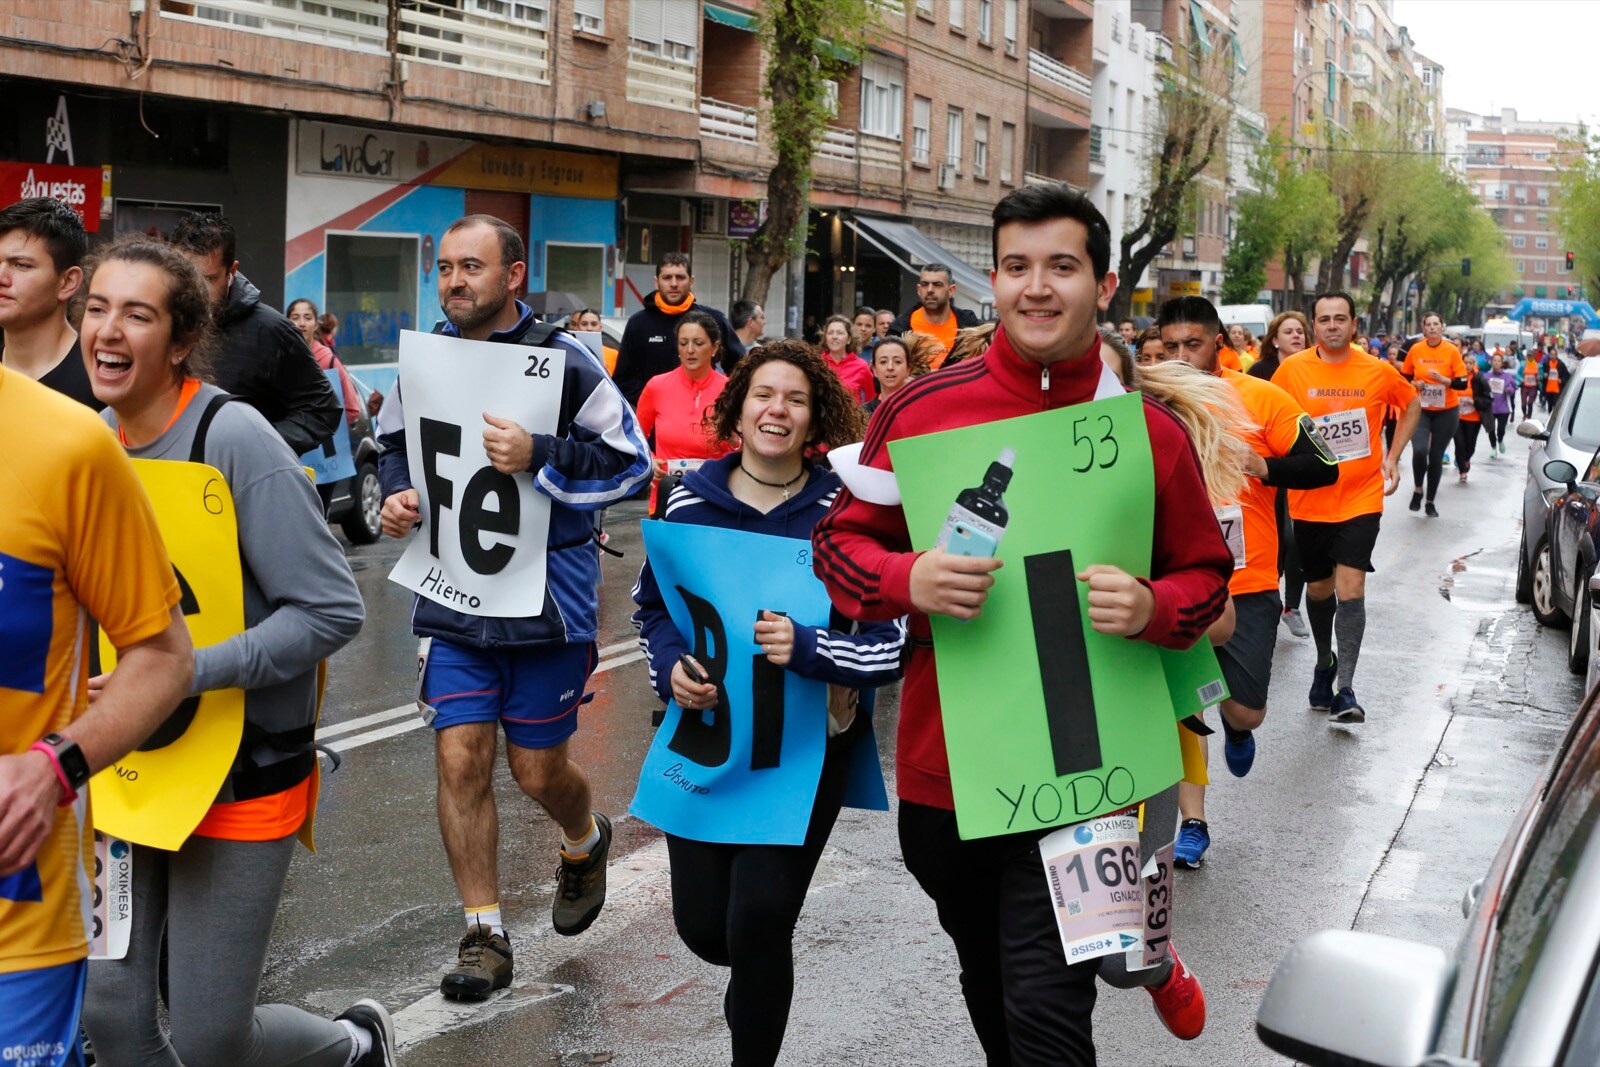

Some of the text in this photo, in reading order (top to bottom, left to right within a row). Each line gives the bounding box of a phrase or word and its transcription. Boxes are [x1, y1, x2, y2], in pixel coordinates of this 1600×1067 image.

[320, 128, 395, 176] LavaCar
[524, 355, 550, 379] 26
[1317, 388, 1366, 397] MARCELINO
[1422, 388, 1442, 398] 2264
[1072, 415, 1119, 474] 53
[1319, 419, 1363, 442] 2255
[203, 478, 223, 514] 6
[420, 417, 520, 576] Fe
[796, 549, 813, 567] 8
[420, 567, 481, 609] Hierro
[996, 766, 1135, 830] YODO
[1094, 819, 1135, 832] OXIMESA
[1049, 865, 1065, 908] MARCELINO
[1065, 845, 1140, 894] 166
[118, 861, 129, 921] OXIMESA
[1146, 862, 1168, 953] 1639
